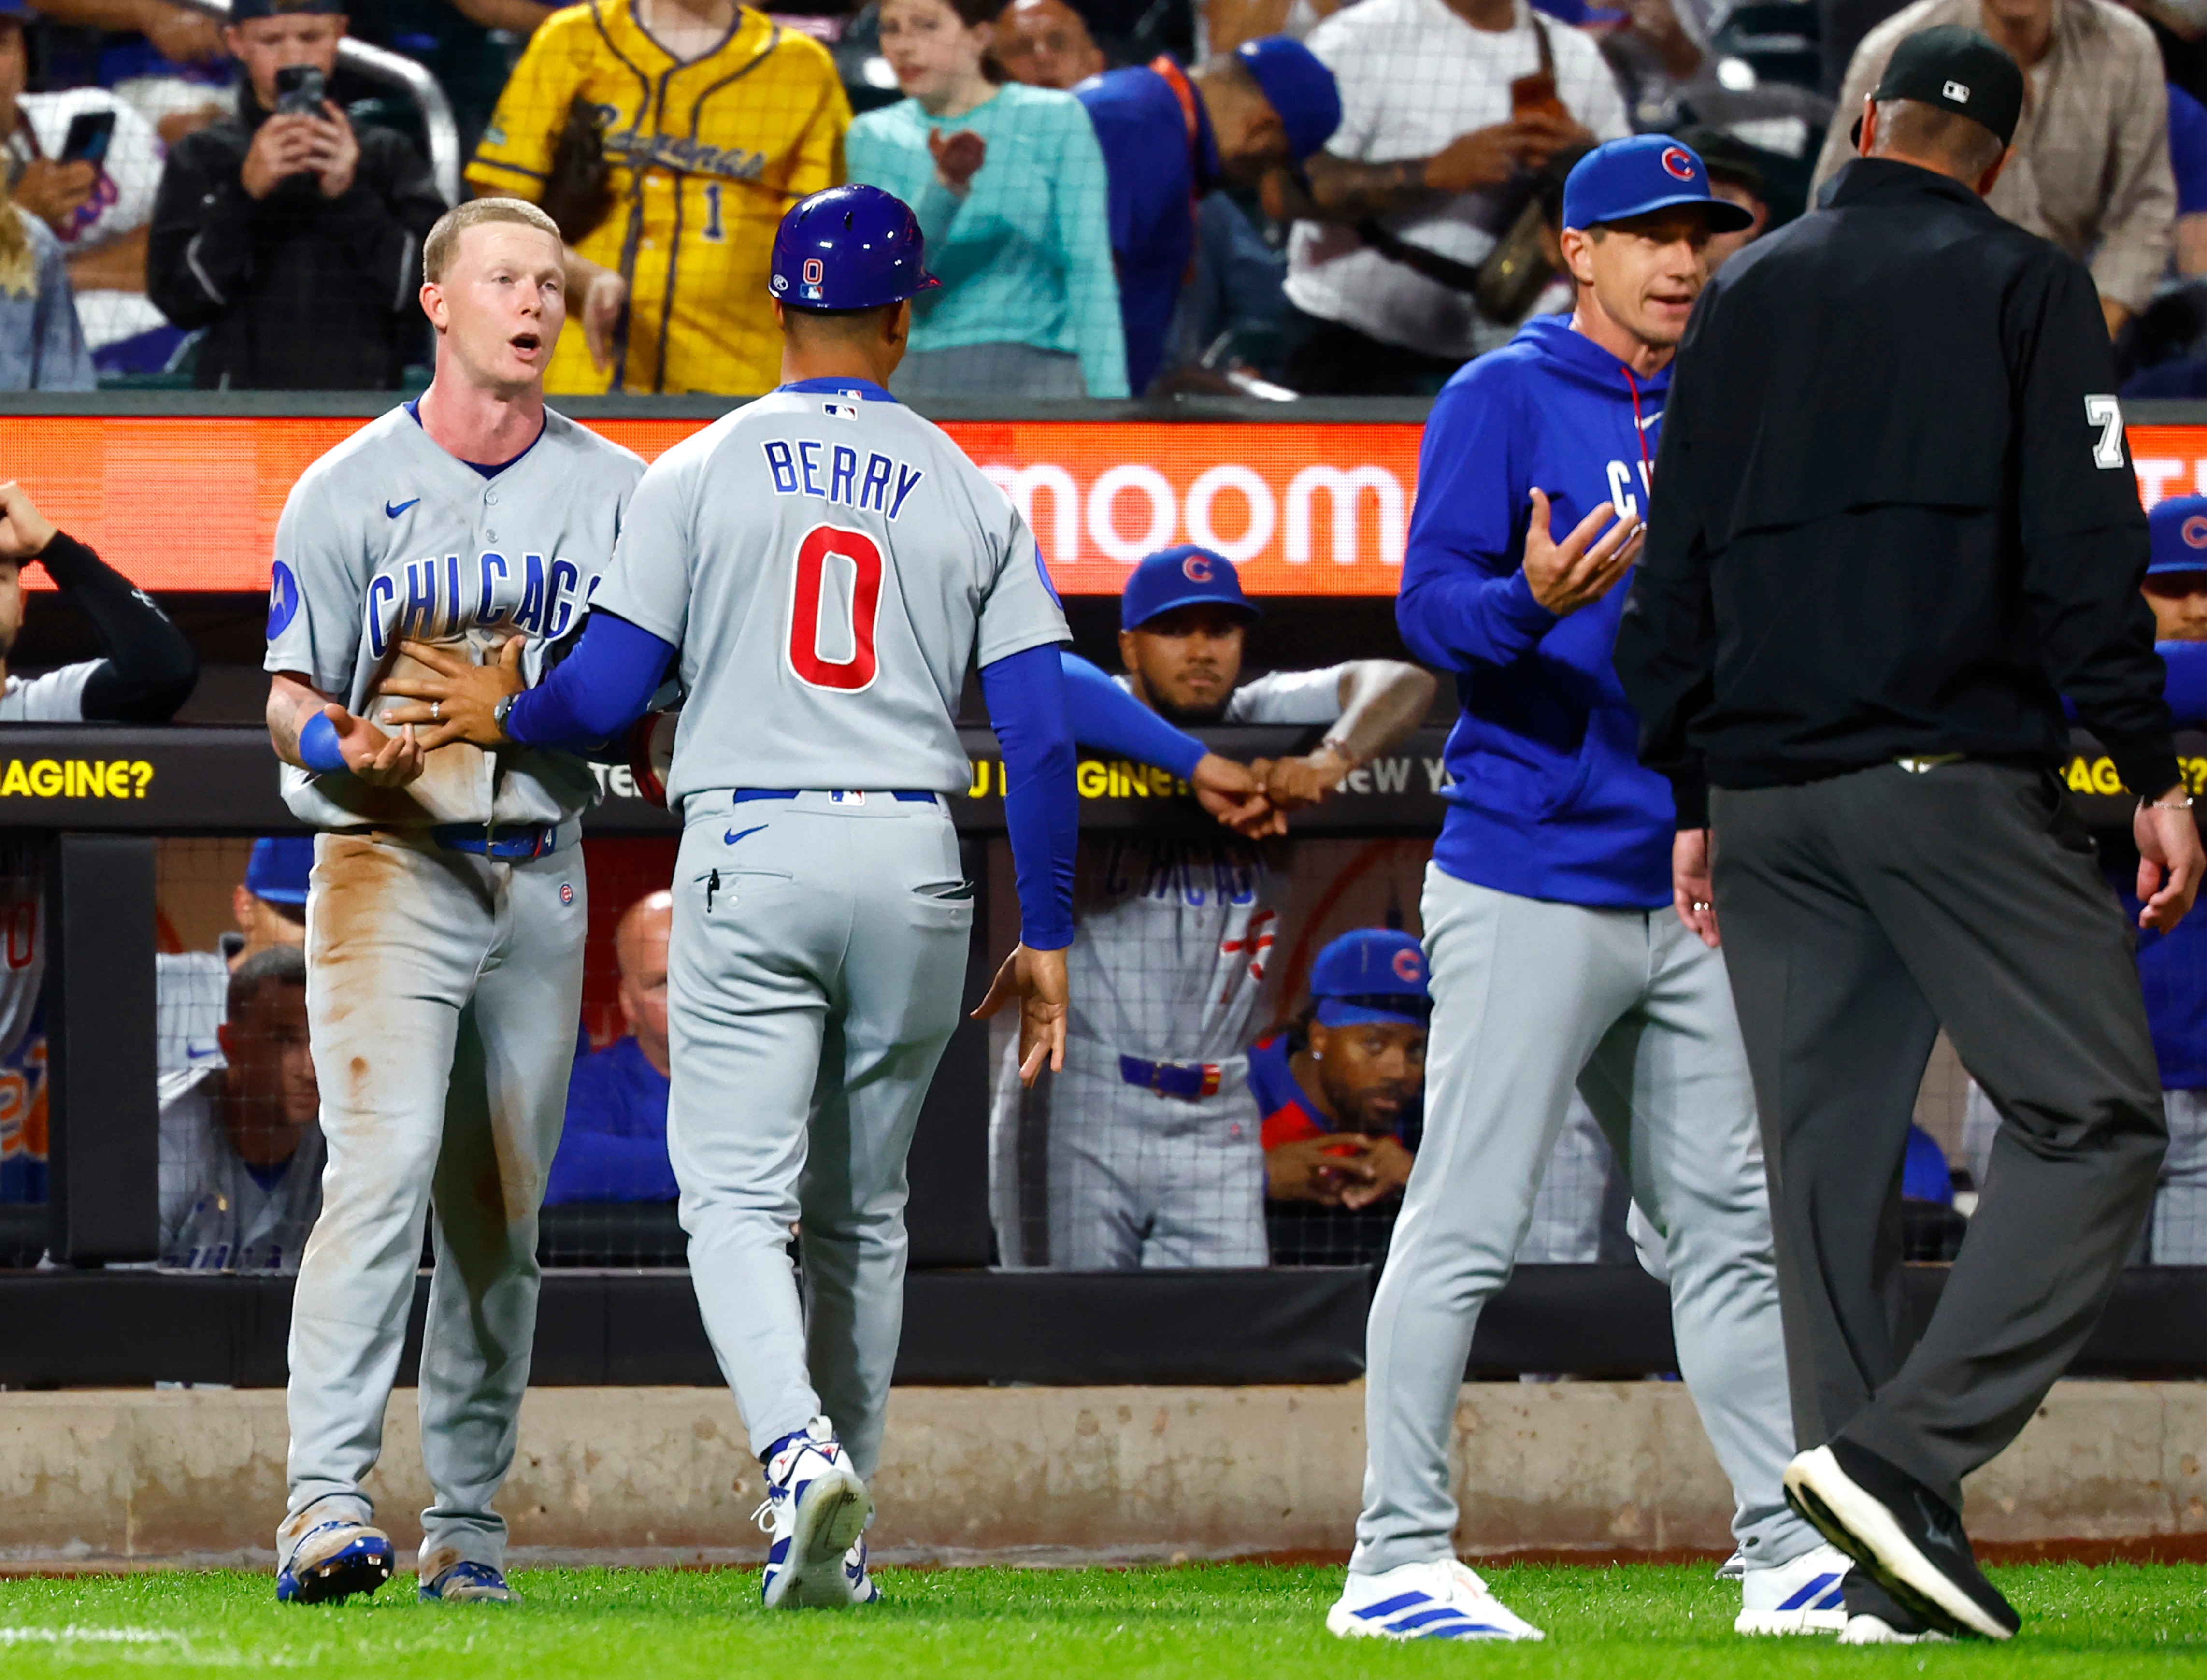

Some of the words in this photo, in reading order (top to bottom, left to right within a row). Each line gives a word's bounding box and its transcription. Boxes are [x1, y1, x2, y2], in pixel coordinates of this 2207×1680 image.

[702, 180, 726, 244] 1
[803, 258, 823, 285] 0
[2084, 394, 2124, 470] 7
[760, 438, 926, 522] BERRY
[785, 521, 885, 694] 0
[0, 758, 155, 799] AGINE?
